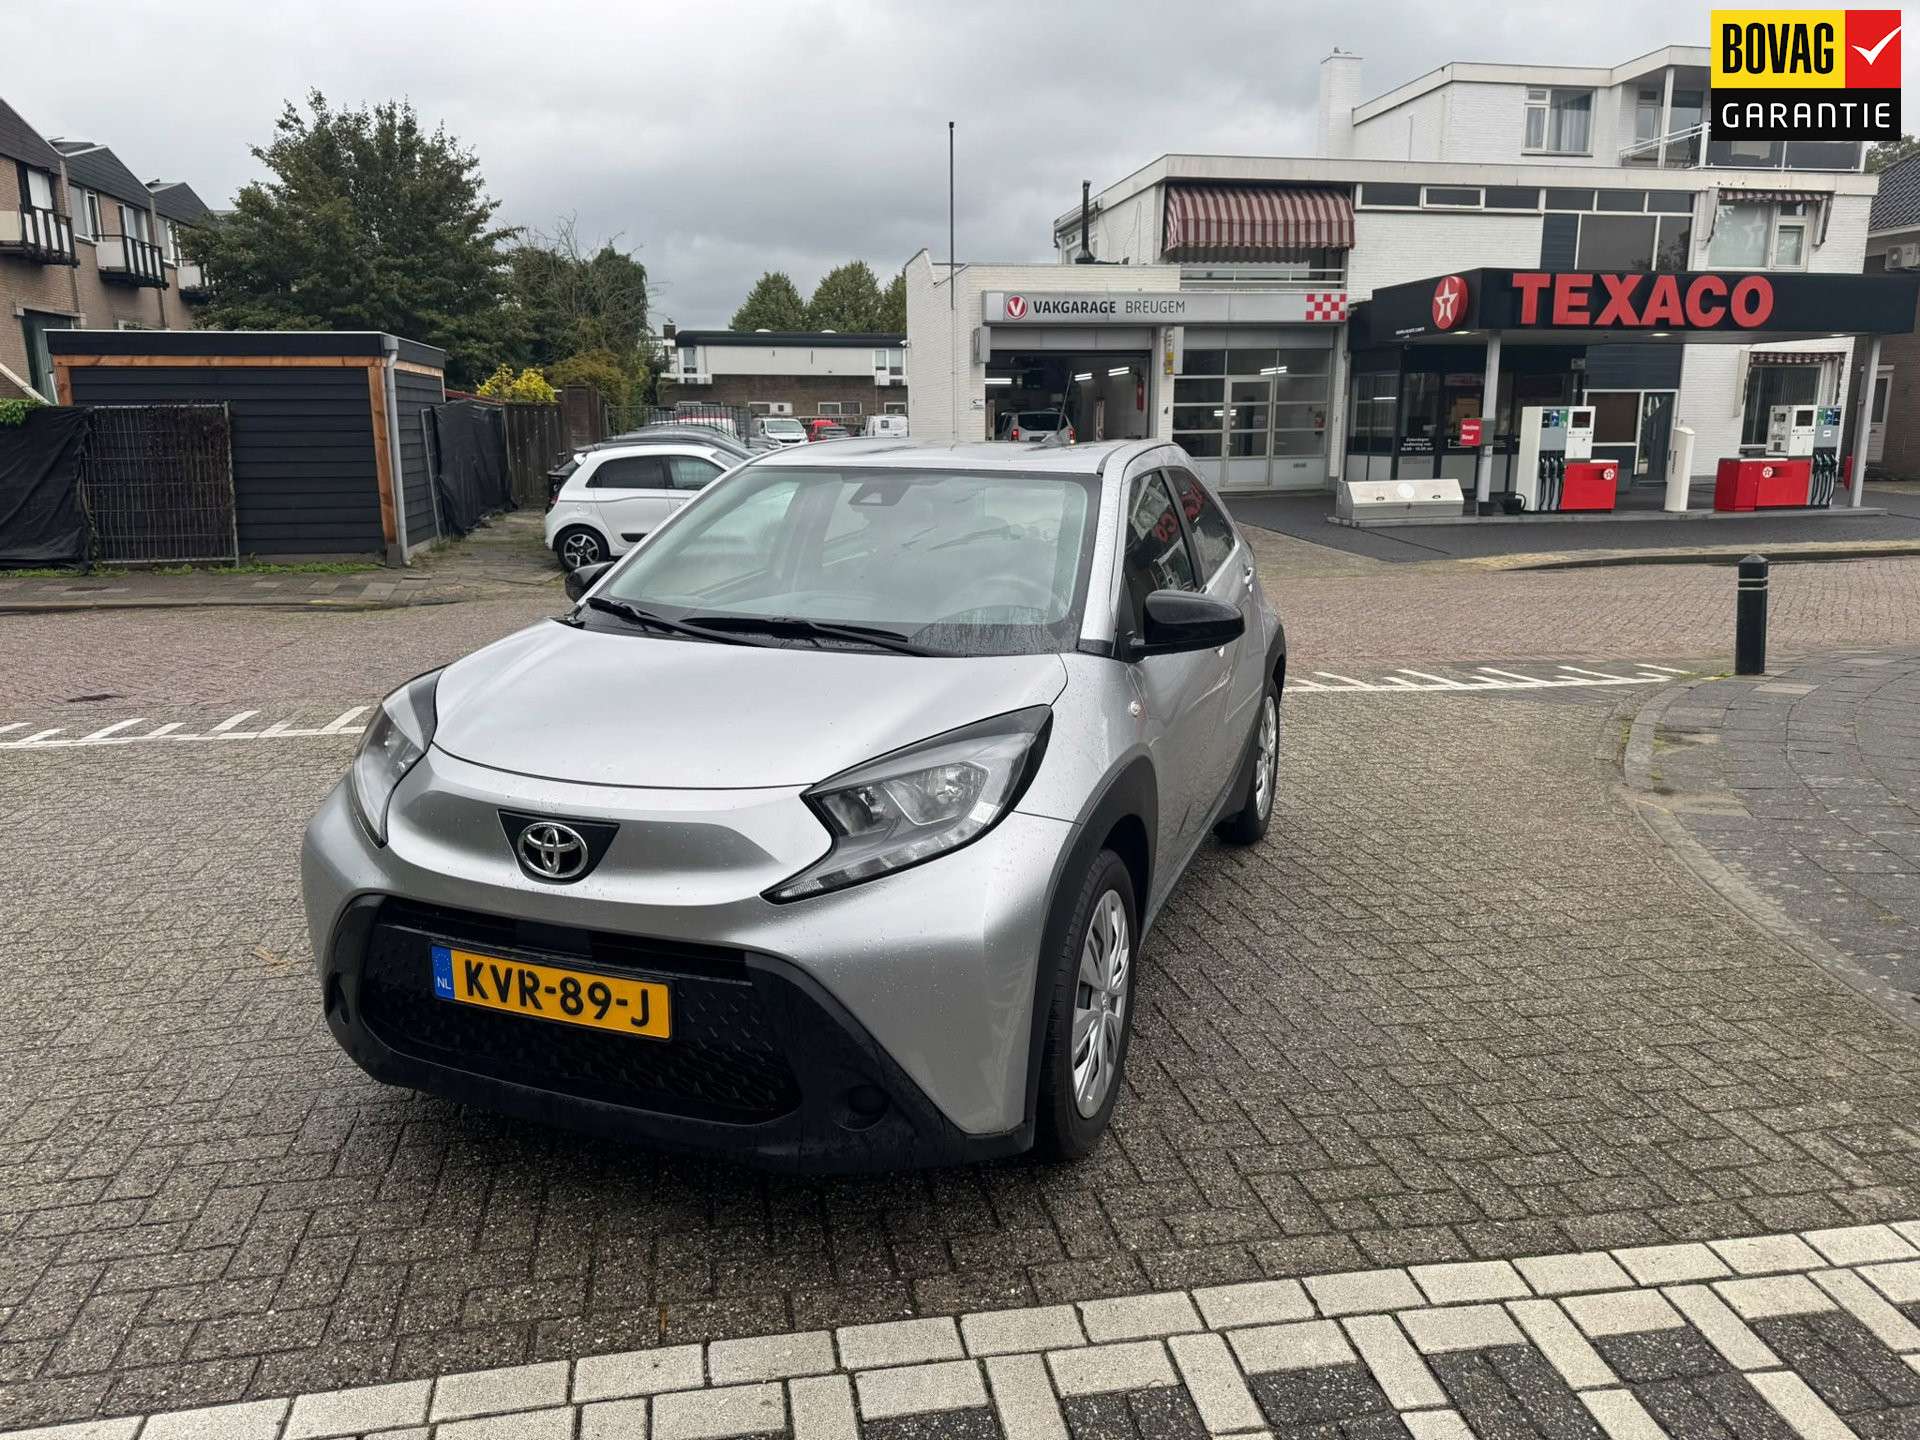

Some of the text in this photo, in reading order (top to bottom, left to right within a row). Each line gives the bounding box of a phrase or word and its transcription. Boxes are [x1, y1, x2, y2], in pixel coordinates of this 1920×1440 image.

[1033, 300, 1186, 314] VAKGARAGE BREUGEM
[1512, 273, 1774, 328] TEXACO
[437, 959, 650, 1028] NL KVR-89-J
